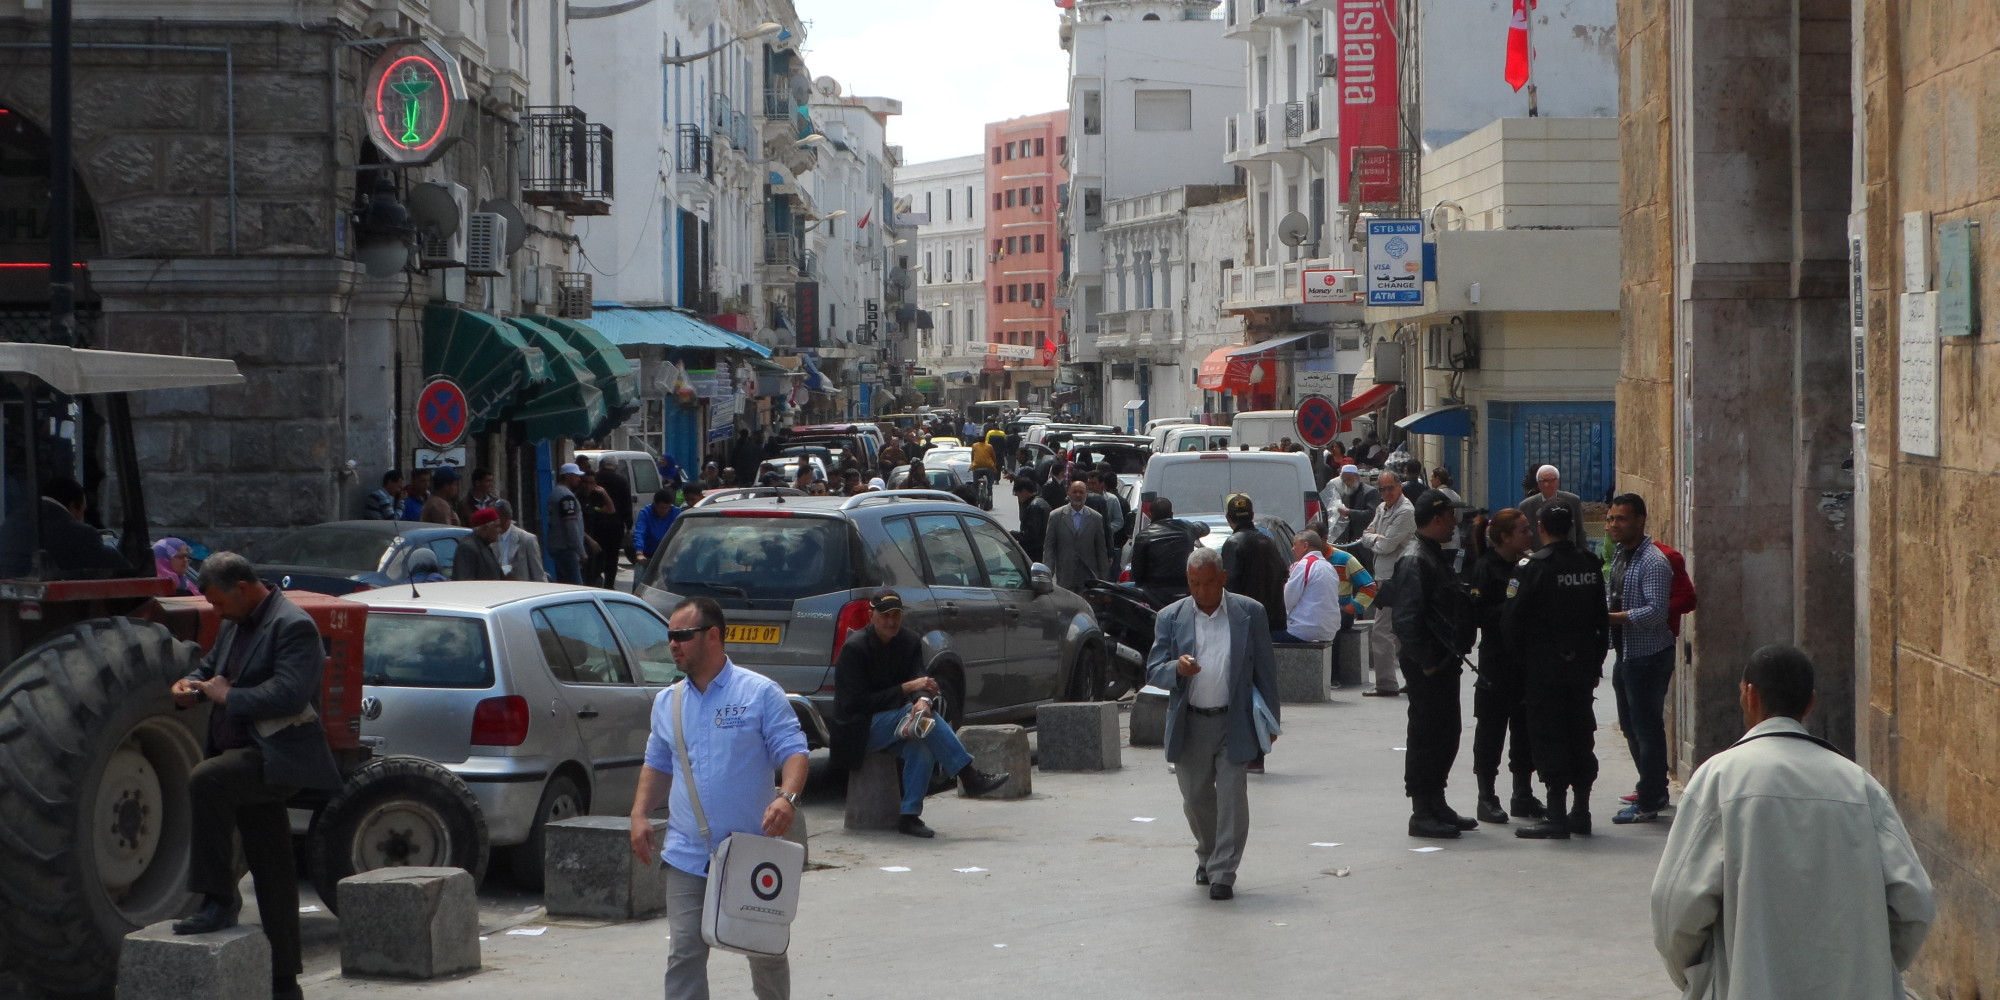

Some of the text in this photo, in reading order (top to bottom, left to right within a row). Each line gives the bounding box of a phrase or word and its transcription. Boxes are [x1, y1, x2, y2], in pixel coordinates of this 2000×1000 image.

[1373, 225, 1394, 233] STB
[1373, 263, 1391, 271] VISA
[1376, 273, 1415, 282] صرف
[1374, 292, 1396, 300] ATM
[867, 299, 878, 341] bank
[1557, 572, 1597, 586] POLICE
[739, 627, 758, 641] 113
[763, 628, 776, 641] 07
